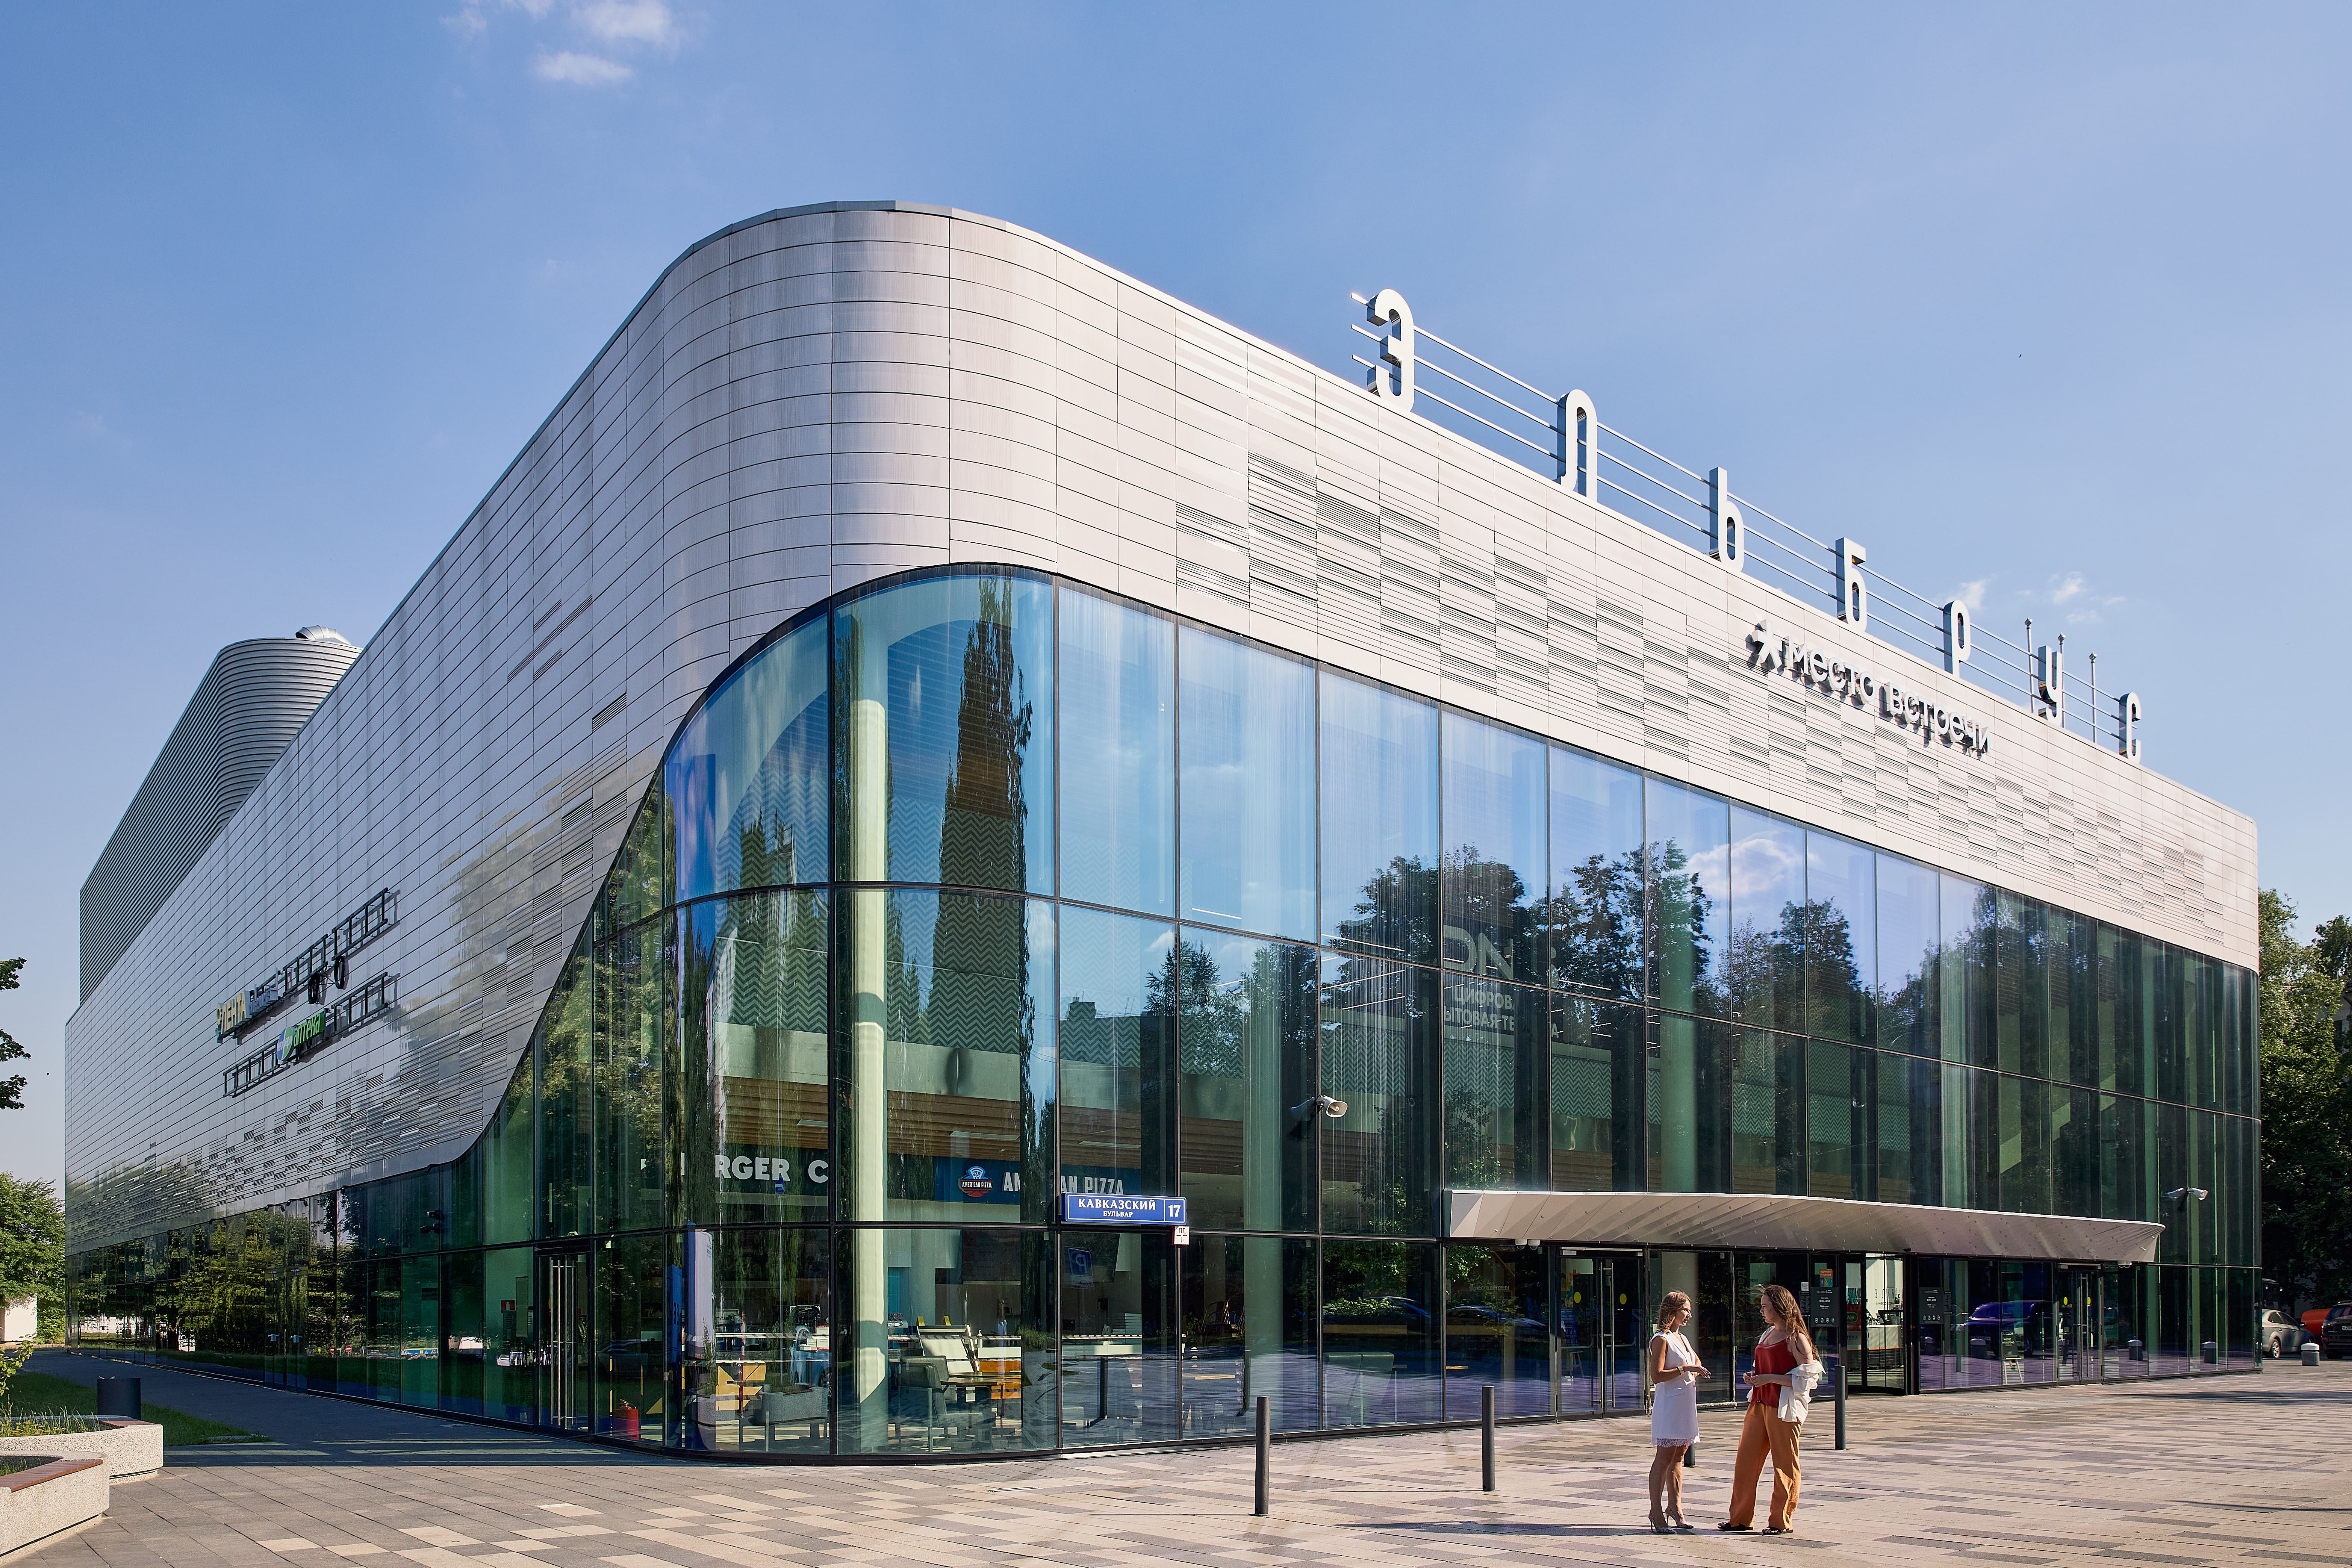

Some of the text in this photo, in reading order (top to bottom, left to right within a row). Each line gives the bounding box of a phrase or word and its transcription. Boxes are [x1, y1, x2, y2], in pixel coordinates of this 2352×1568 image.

[1367, 288, 2142, 764] ЭЛЬБРУС
[1788, 635, 1990, 754] место встречи
[220, 990, 249, 1034] ЛЕНТА
[1454, 985, 1514, 1011] ЦИФРОВ
[294, 1013, 321, 1047] аптека
[1444, 1005, 1497, 1029] ЫТОВАЯ
[681, 1152, 790, 1181] RGER
[1085, 1176, 1124, 1194] PIZZA
[1078, 1198, 1181, 1217] КАВКАЗСКИЙ 17
